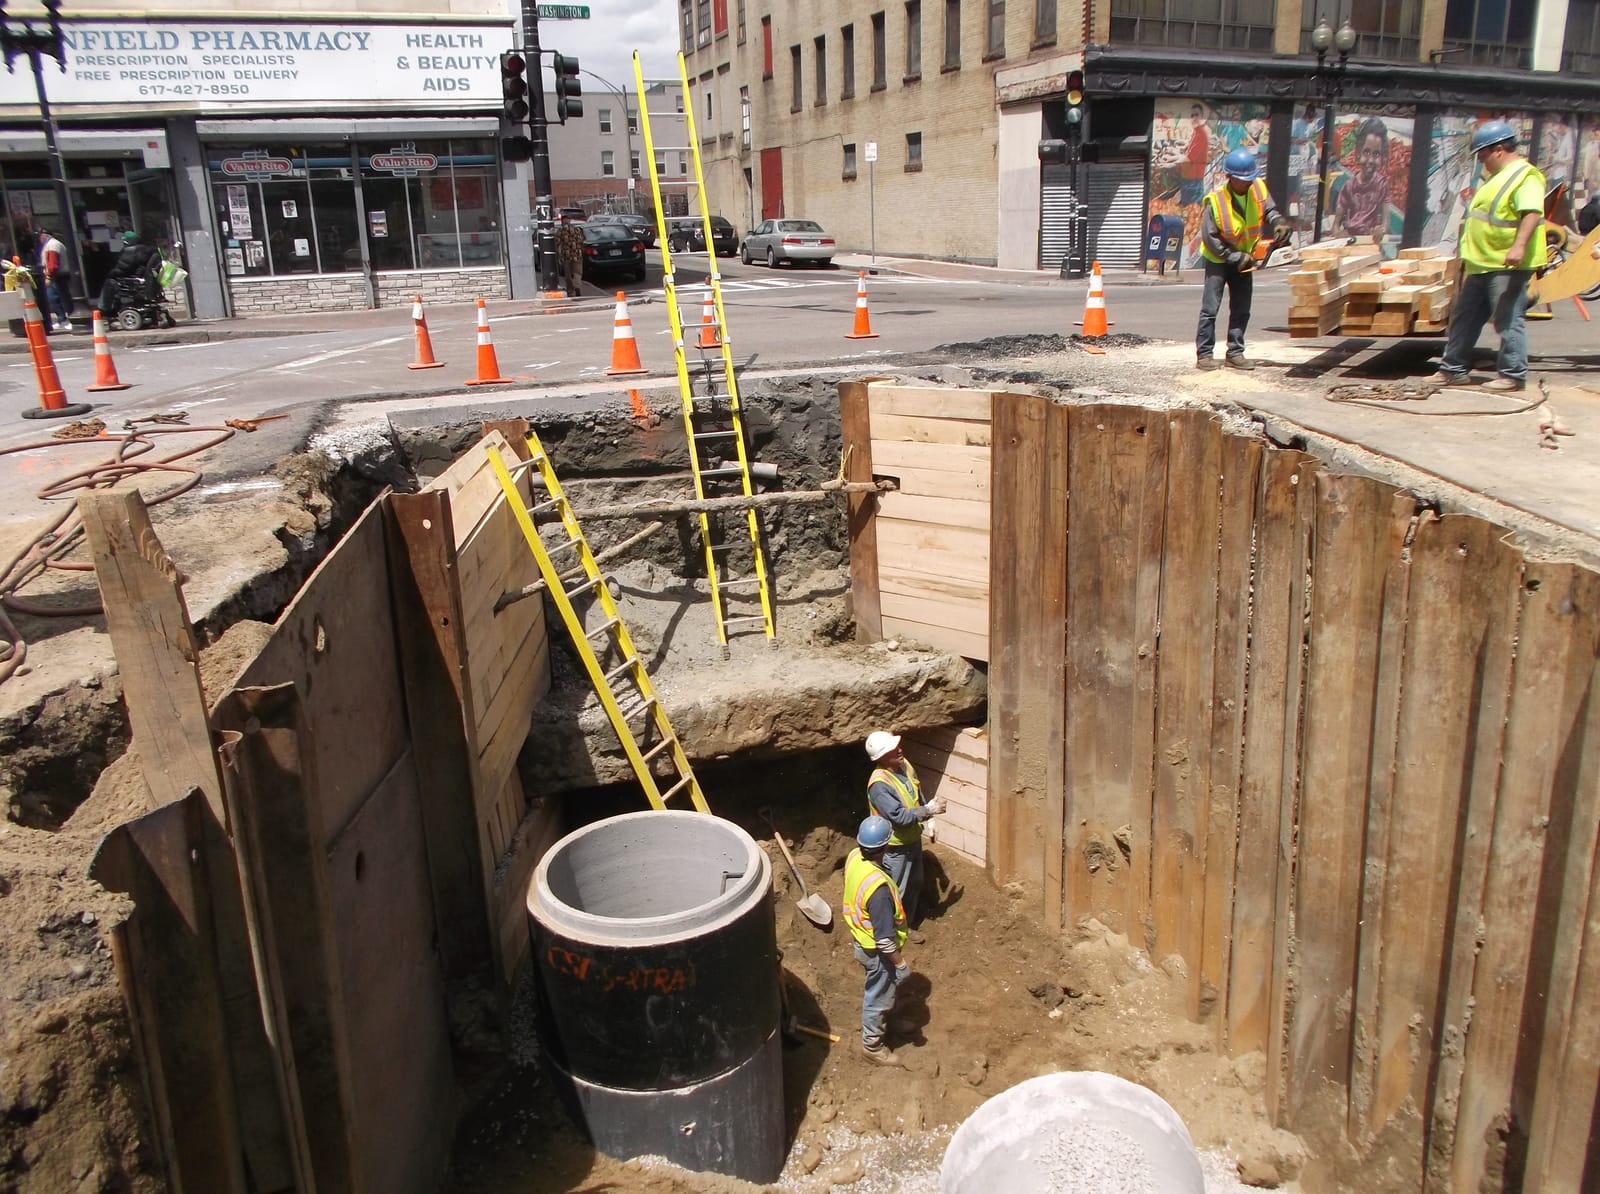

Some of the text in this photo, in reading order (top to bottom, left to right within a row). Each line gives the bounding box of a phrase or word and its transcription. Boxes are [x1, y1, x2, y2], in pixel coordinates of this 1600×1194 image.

[538, 6, 582, 17] WASHINGTON
[190, 30, 371, 51] PHARMACY
[406, 33, 483, 48] HEALTH
[75, 55, 295, 66] PRESCRIPTION SPECIALISTS
[396, 56, 497, 70] & BEAUTY
[75, 70, 299, 81] FREE PRESCRIPTION DELIVERY
[138, 84, 250, 95] 617-427-8950
[422, 77, 471, 92] AIDS
